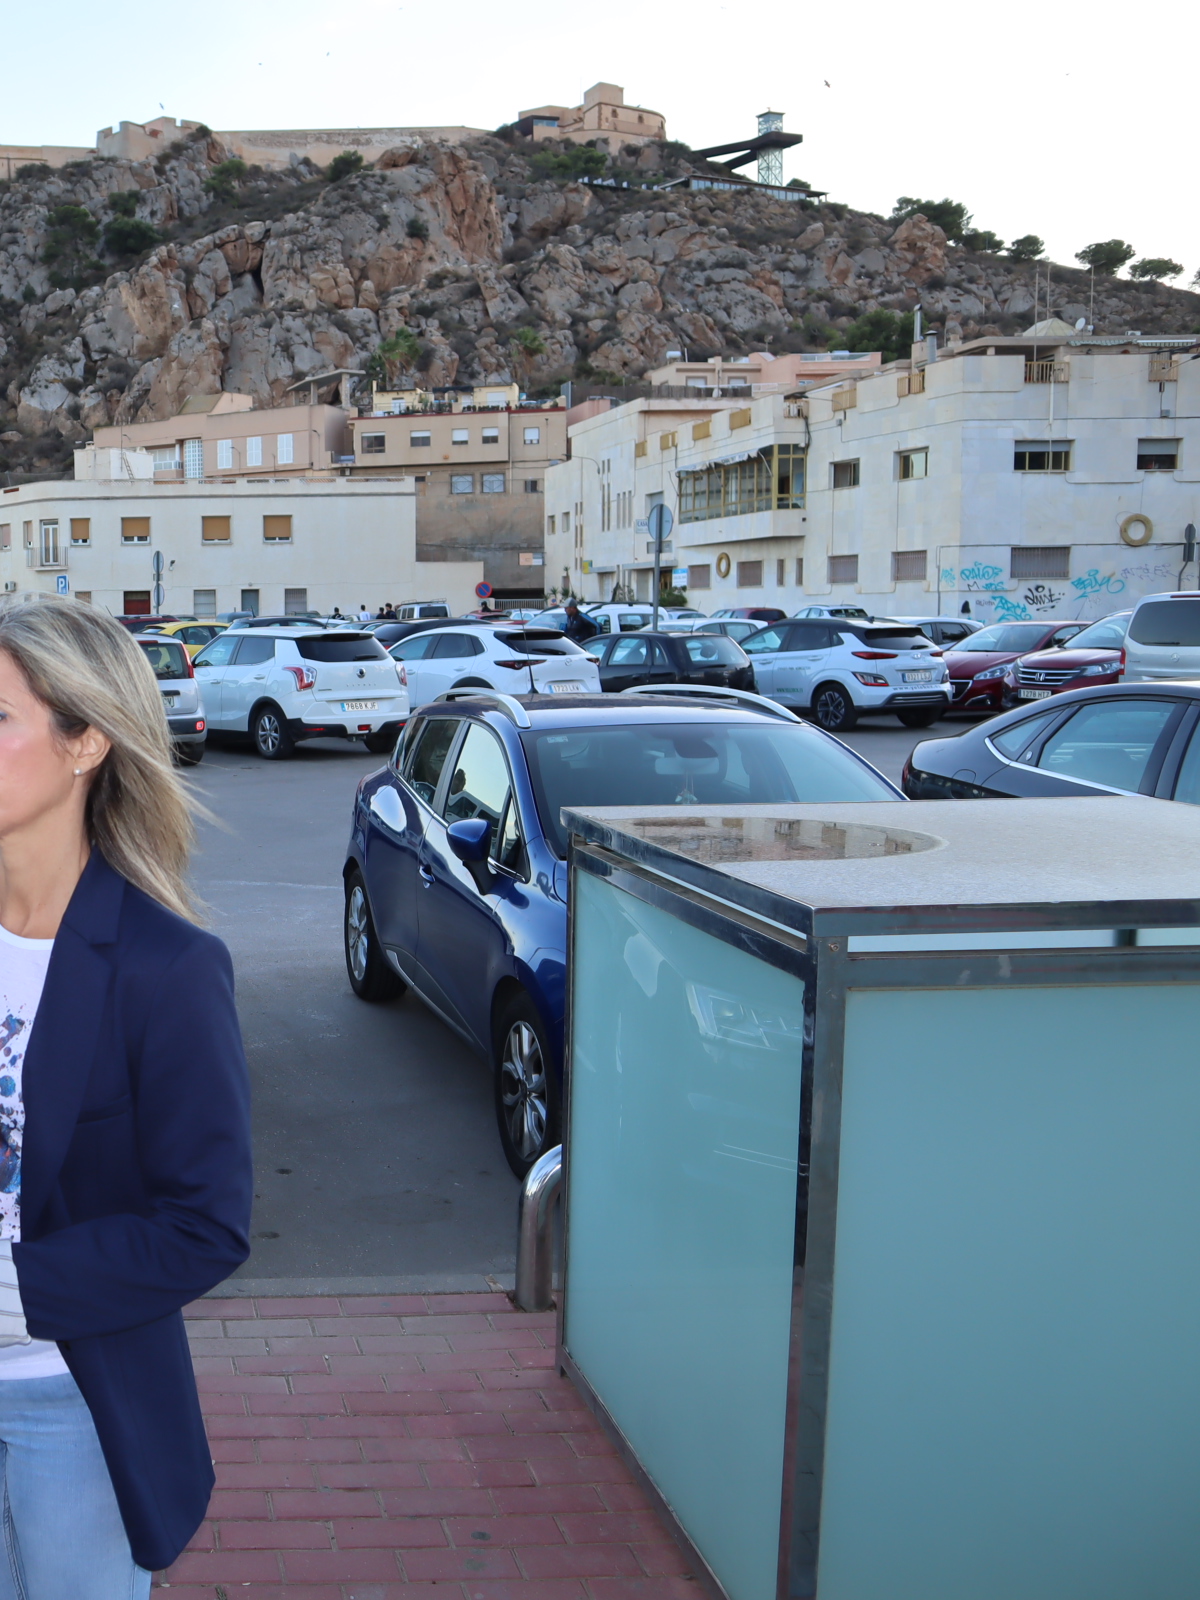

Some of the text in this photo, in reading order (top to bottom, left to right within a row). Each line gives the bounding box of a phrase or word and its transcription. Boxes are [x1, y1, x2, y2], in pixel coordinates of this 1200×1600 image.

[58, 577, 66, 589] P
[345, 702, 377, 710] 7868 KJF
